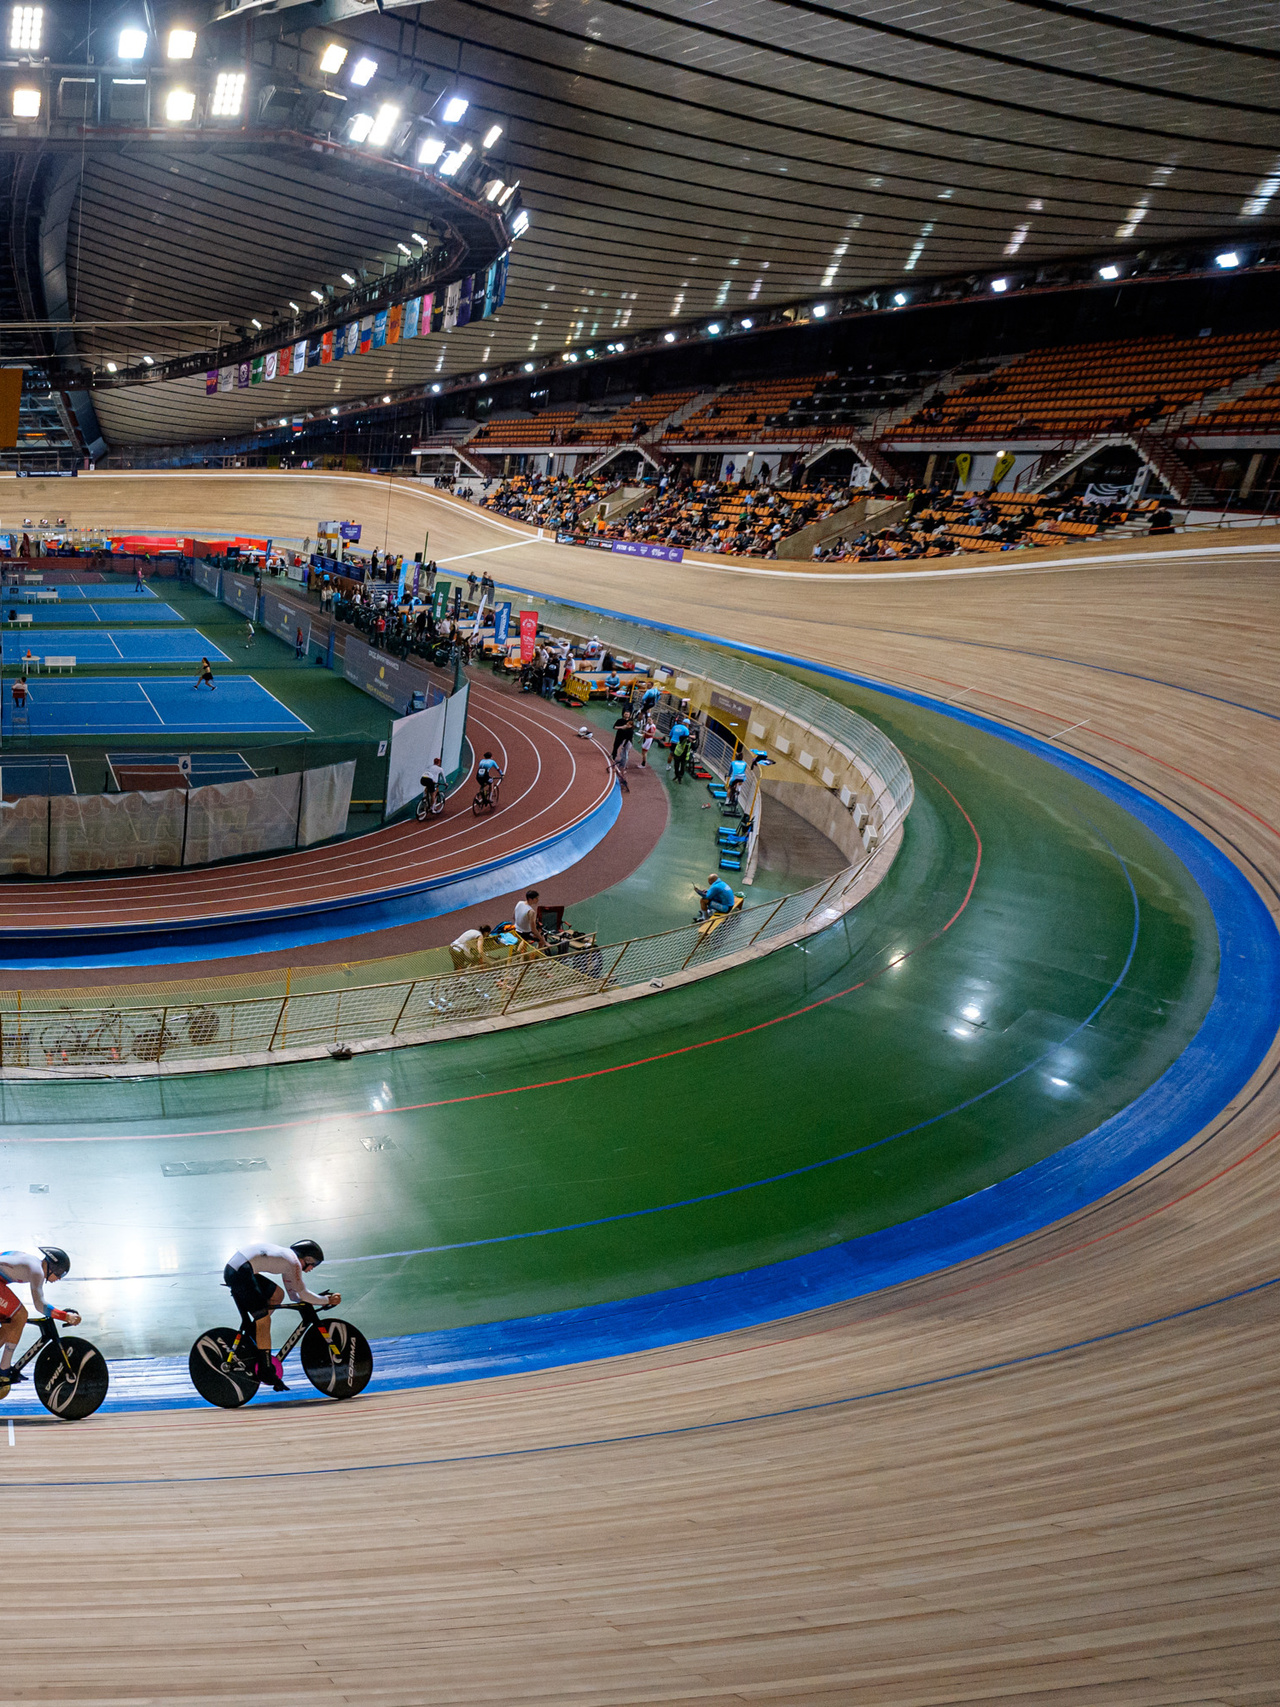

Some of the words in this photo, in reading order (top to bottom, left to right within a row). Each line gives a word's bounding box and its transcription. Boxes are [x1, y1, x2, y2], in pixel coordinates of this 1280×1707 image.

[380, 744, 385, 753] 7
[182, 760, 189, 770] 6
[14, 1338, 44, 1370] OOK
[277, 1322, 306, 1361] LOOK
[348, 1337, 357, 1387] CORIMA
